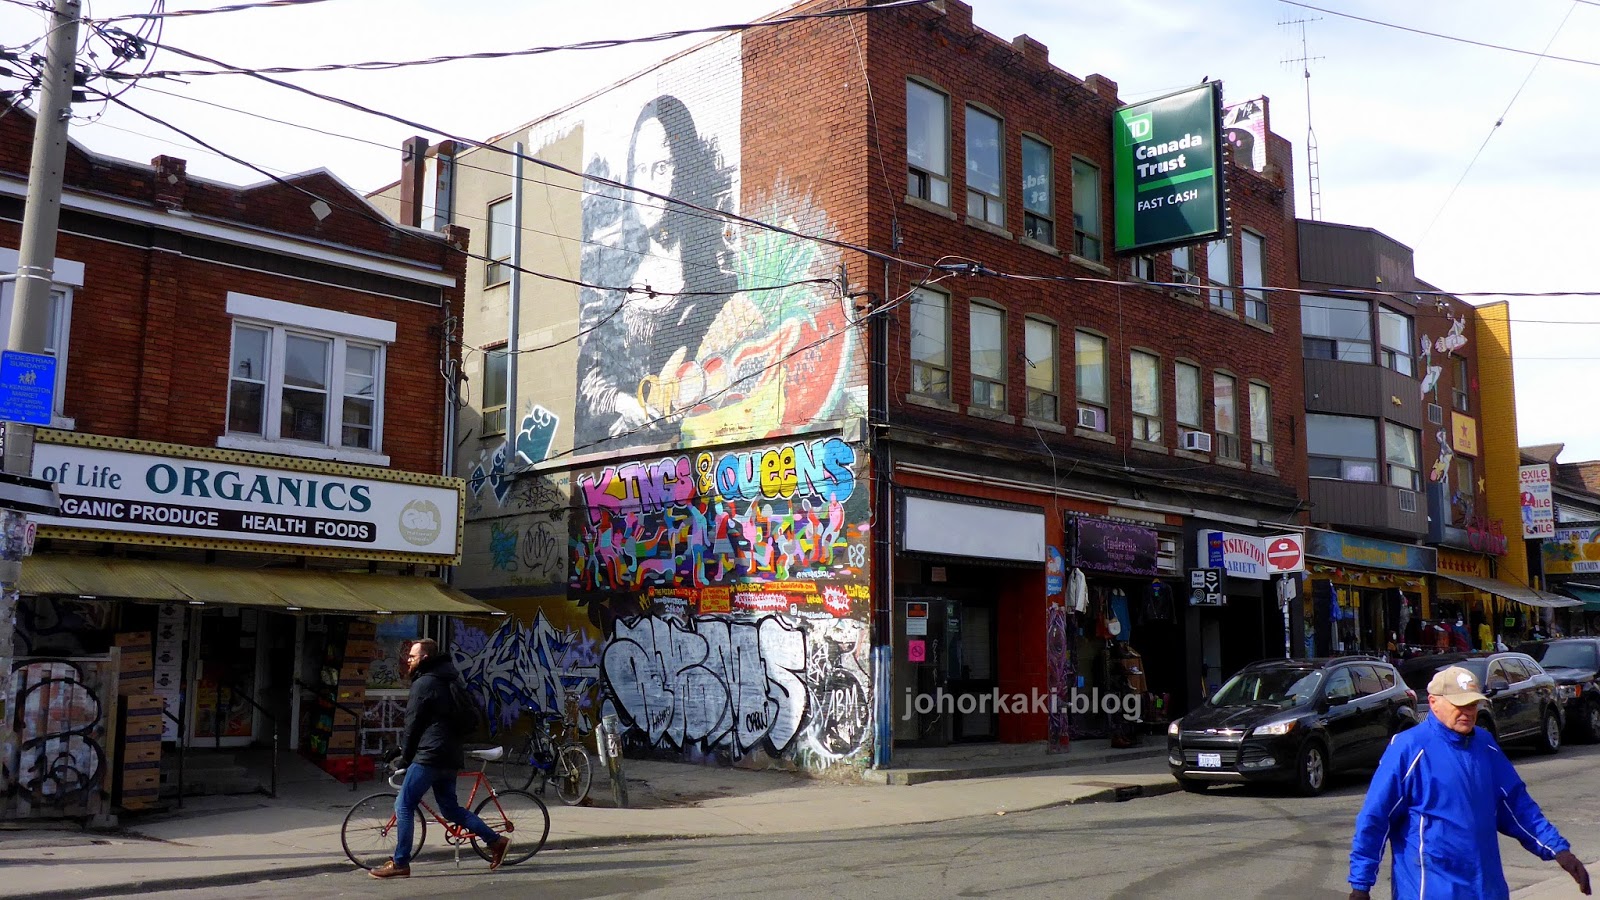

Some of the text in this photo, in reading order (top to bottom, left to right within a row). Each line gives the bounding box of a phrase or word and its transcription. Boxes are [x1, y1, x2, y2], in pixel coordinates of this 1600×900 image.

[1128, 118, 1150, 138] TD
[1136, 133, 1202, 160] Canada
[1137, 153, 1186, 178] Trust
[1137, 189, 1198, 212] FAST CASH
[4, 353, 54, 366] PEDESTRIAN
[9, 361, 47, 371] SUNDAYS
[9, 384, 51, 394] KENSINGTON
[12, 391, 39, 399] MARKET
[42, 463, 372, 513] of Life ORGANICS
[581, 454, 696, 526] KINGS
[695, 450, 714, 496] &
[65, 499, 369, 539] GANIC PRODUCE HEALTH FOODS
[1223, 538, 1265, 567] NSINGTON
[1225, 560, 1257, 574] ARIETY
